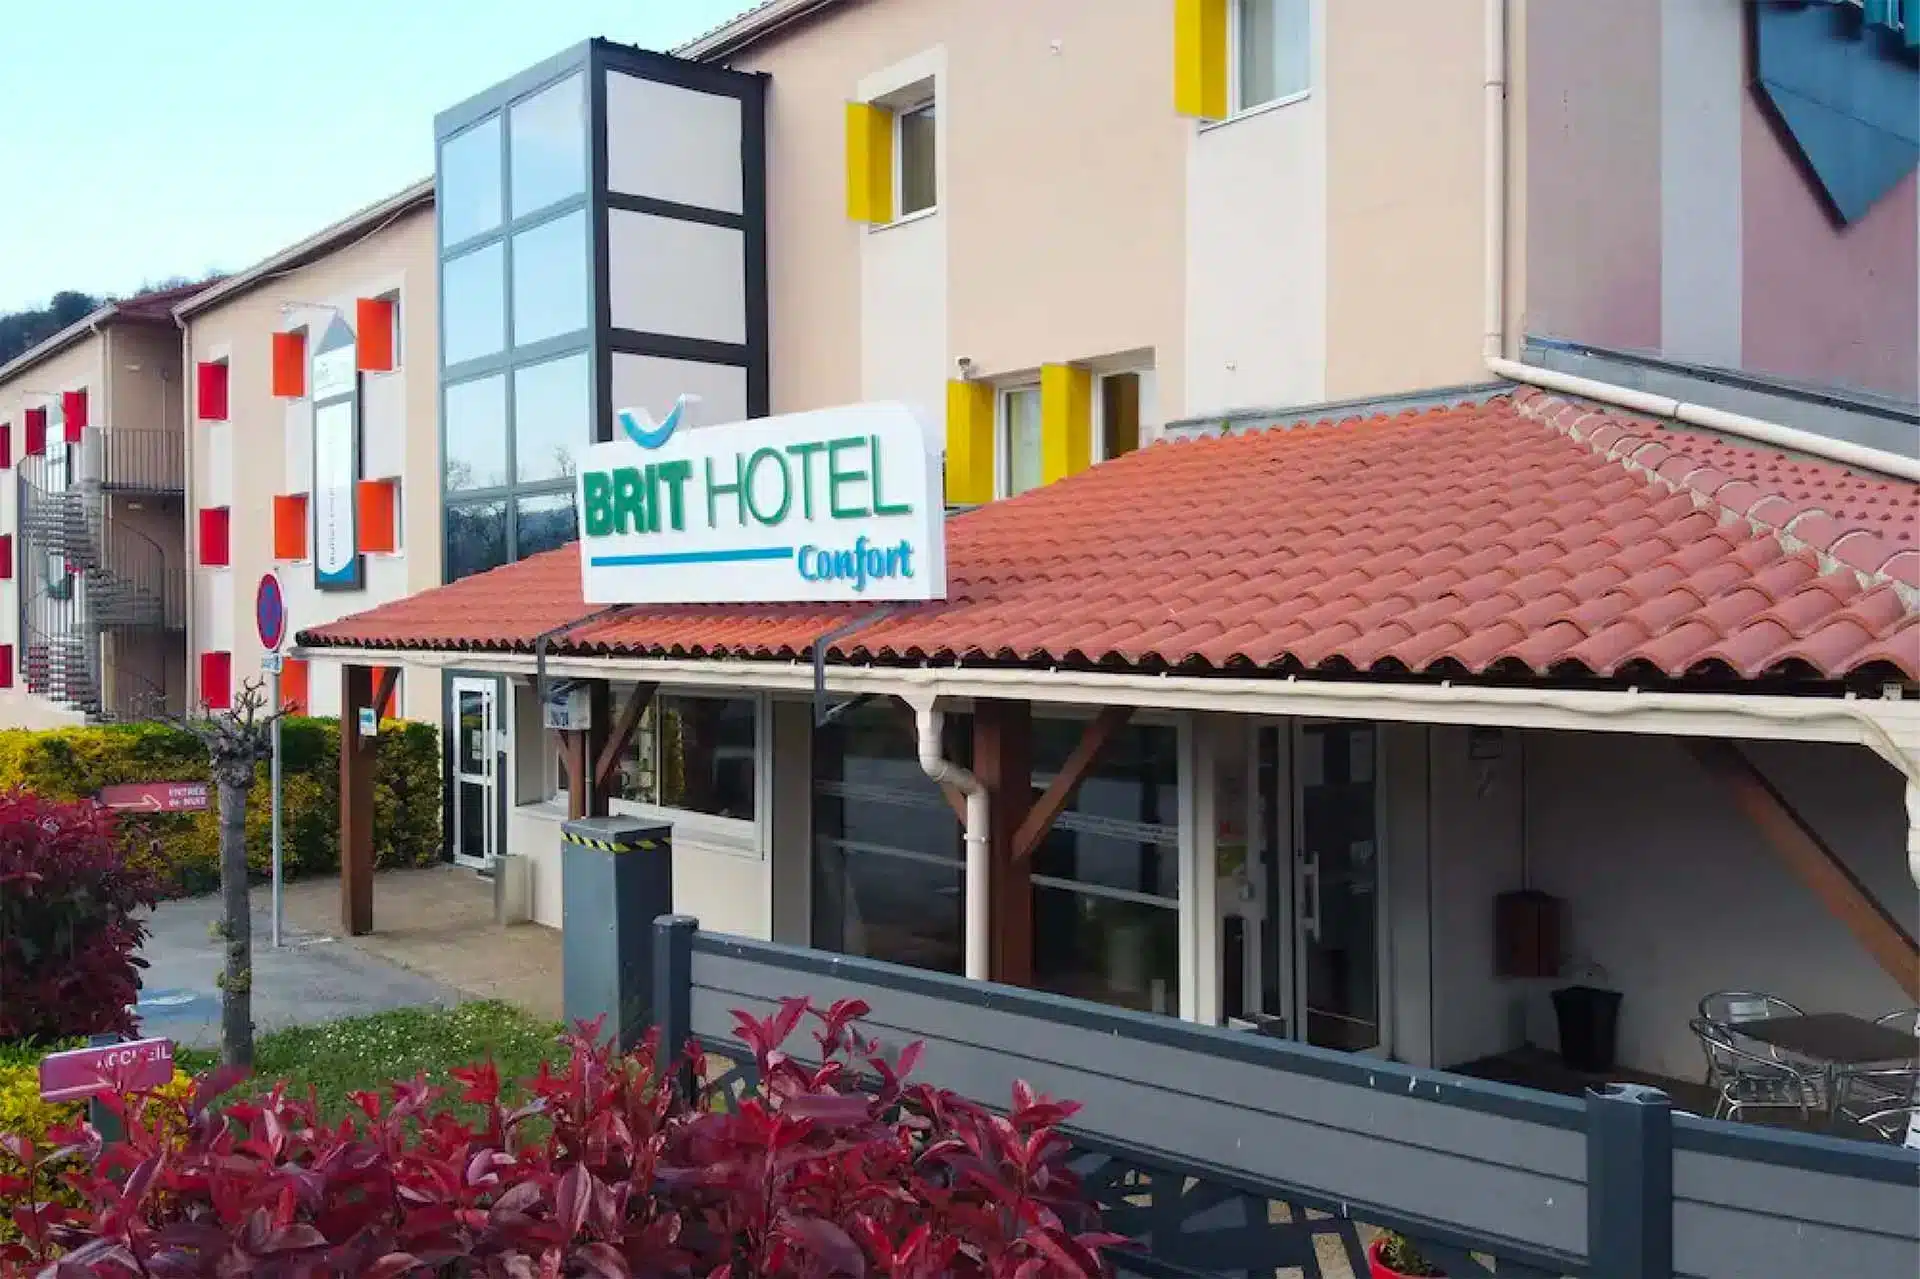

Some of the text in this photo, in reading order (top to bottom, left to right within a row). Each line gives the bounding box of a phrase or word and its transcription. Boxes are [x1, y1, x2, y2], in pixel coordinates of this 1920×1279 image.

[583, 434, 912, 536] BRIT HOTEL
[798, 534, 914, 592] Confort
